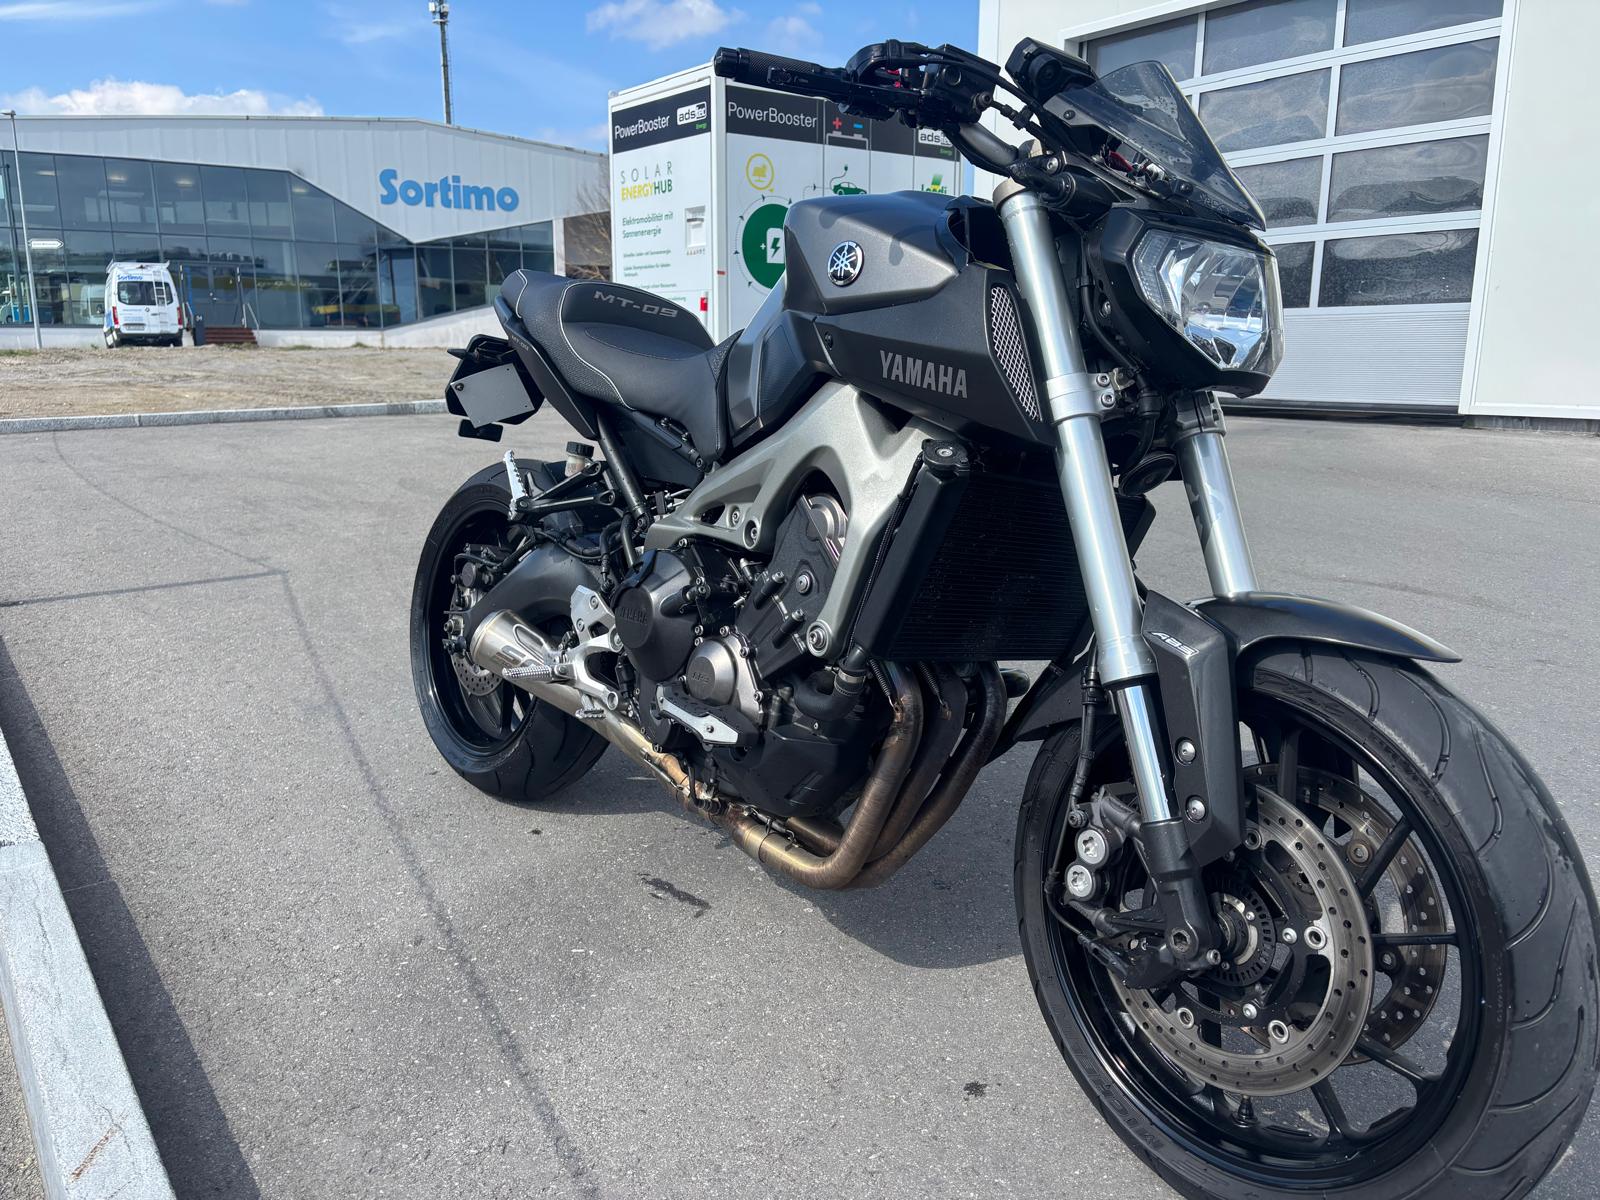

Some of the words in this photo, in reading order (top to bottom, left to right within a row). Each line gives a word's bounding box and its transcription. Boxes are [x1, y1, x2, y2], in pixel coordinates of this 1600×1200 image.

[614, 115, 670, 140] PowerBooster
[728, 101, 818, 128] PowerBooster
[620, 161, 672, 184] SOLAR
[379, 168, 520, 212] Sortimo
[621, 179, 673, 202] ENERGYHUB
[594, 290, 678, 318] MT-09
[880, 349, 968, 399] YAMAHA
[1151, 631, 1196, 656] ABS
